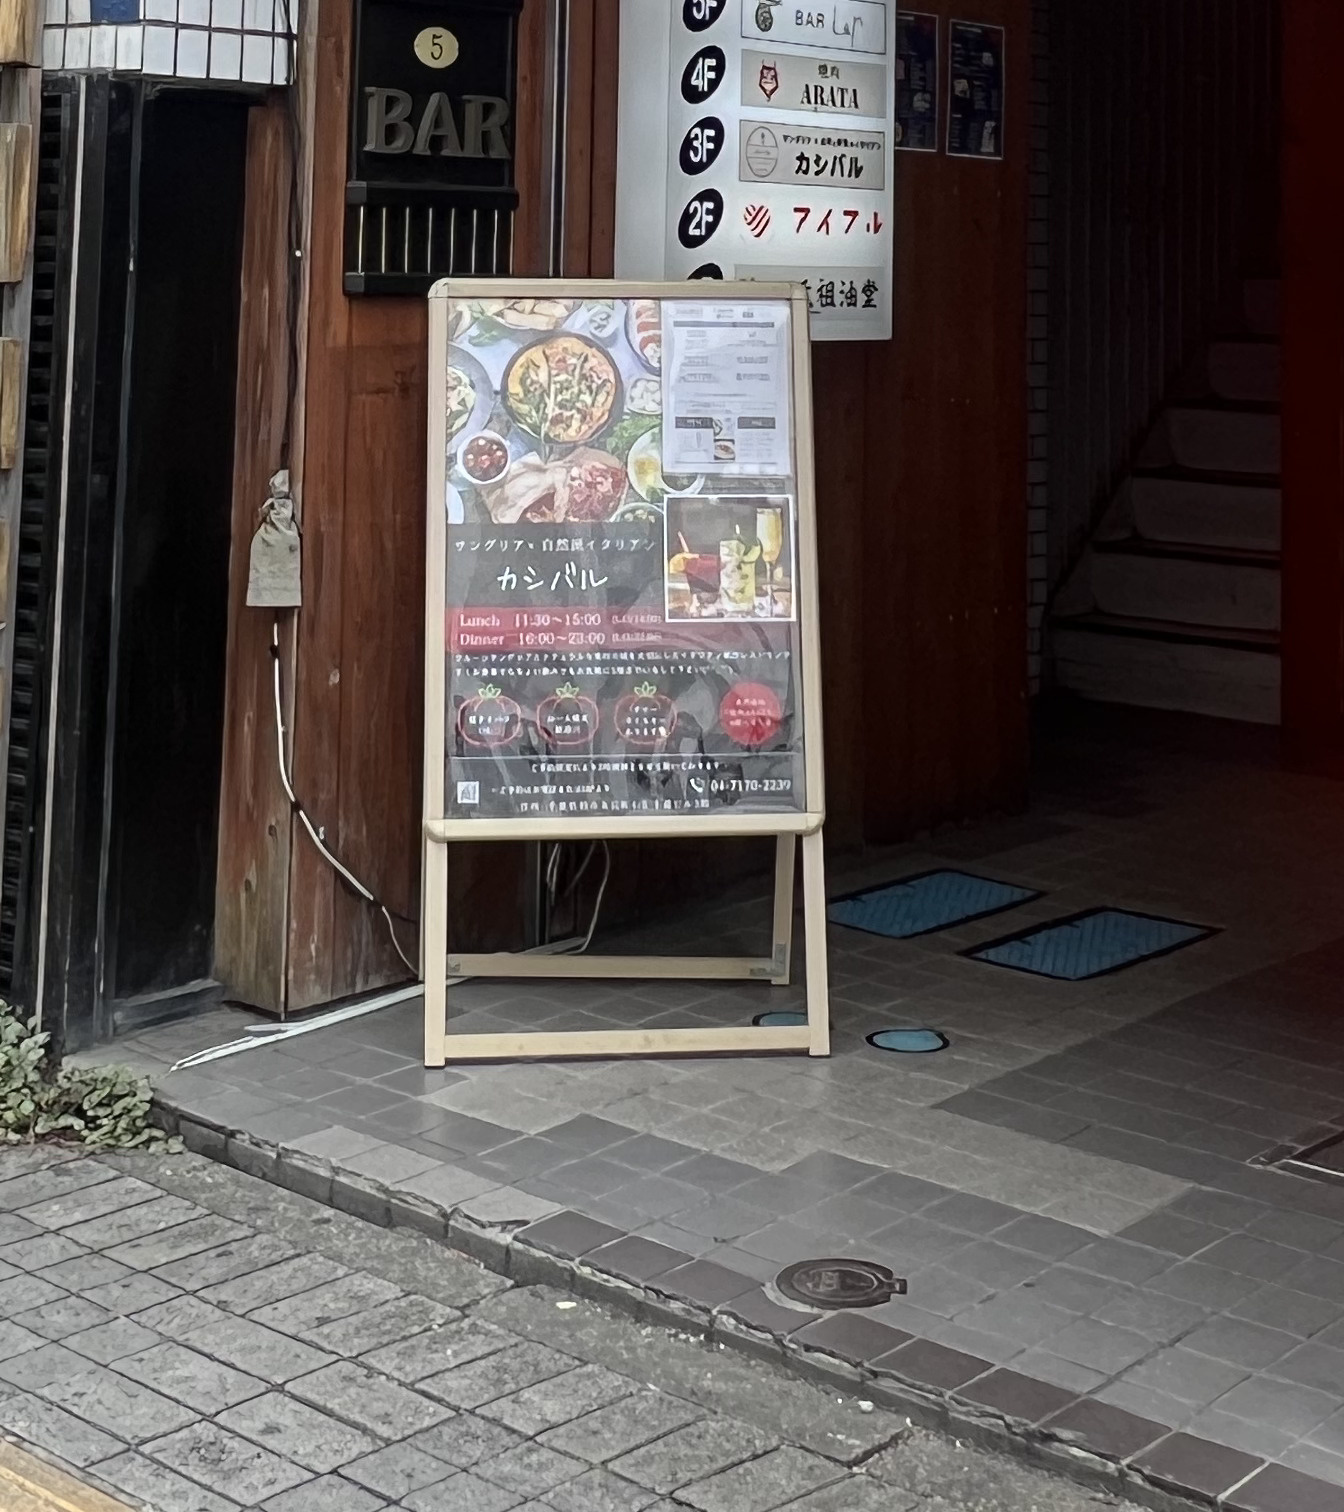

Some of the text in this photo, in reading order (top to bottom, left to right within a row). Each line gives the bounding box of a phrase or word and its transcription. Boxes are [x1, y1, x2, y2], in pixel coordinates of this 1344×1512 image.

[795, 9, 825, 29] BAR
[430, 34, 443, 60] 5
[690, 57, 716, 92] 4F
[800, 83, 859, 110] ARATA
[363, 87, 512, 159] BAR
[689, 127, 716, 162] 3F
[794, 152, 864, 179] カシバル
[688, 200, 714, 236] 2F
[793, 207, 883, 236] アイフル
[497, 561, 608, 591] カシバル
[460, 613, 500, 628] Lunch
[460, 632, 504, 646] Dinner
